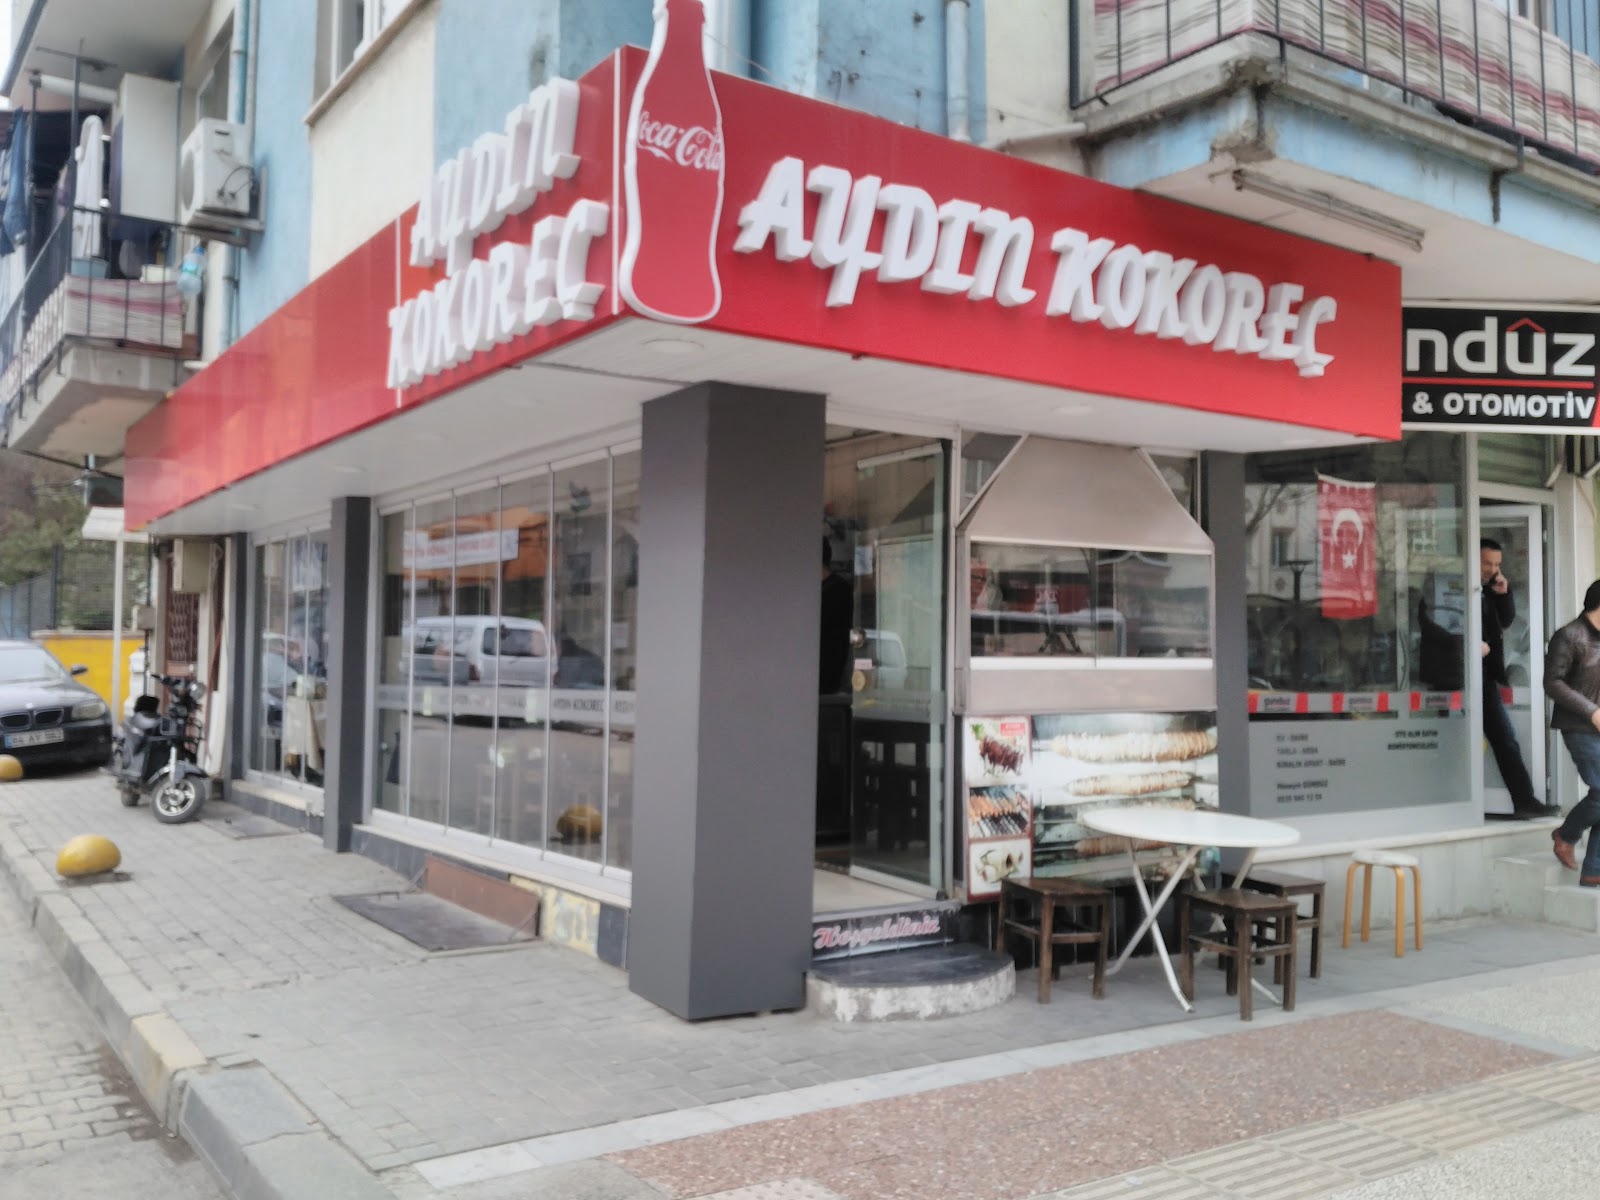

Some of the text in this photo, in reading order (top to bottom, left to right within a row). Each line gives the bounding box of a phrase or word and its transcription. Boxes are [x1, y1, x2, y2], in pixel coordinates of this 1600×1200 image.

[387, 198, 609, 390] KOKOREÇ
[1046, 228, 1337, 377] KOKOREÇ
[1412, 391, 1596, 419] & OTOMOTİV
